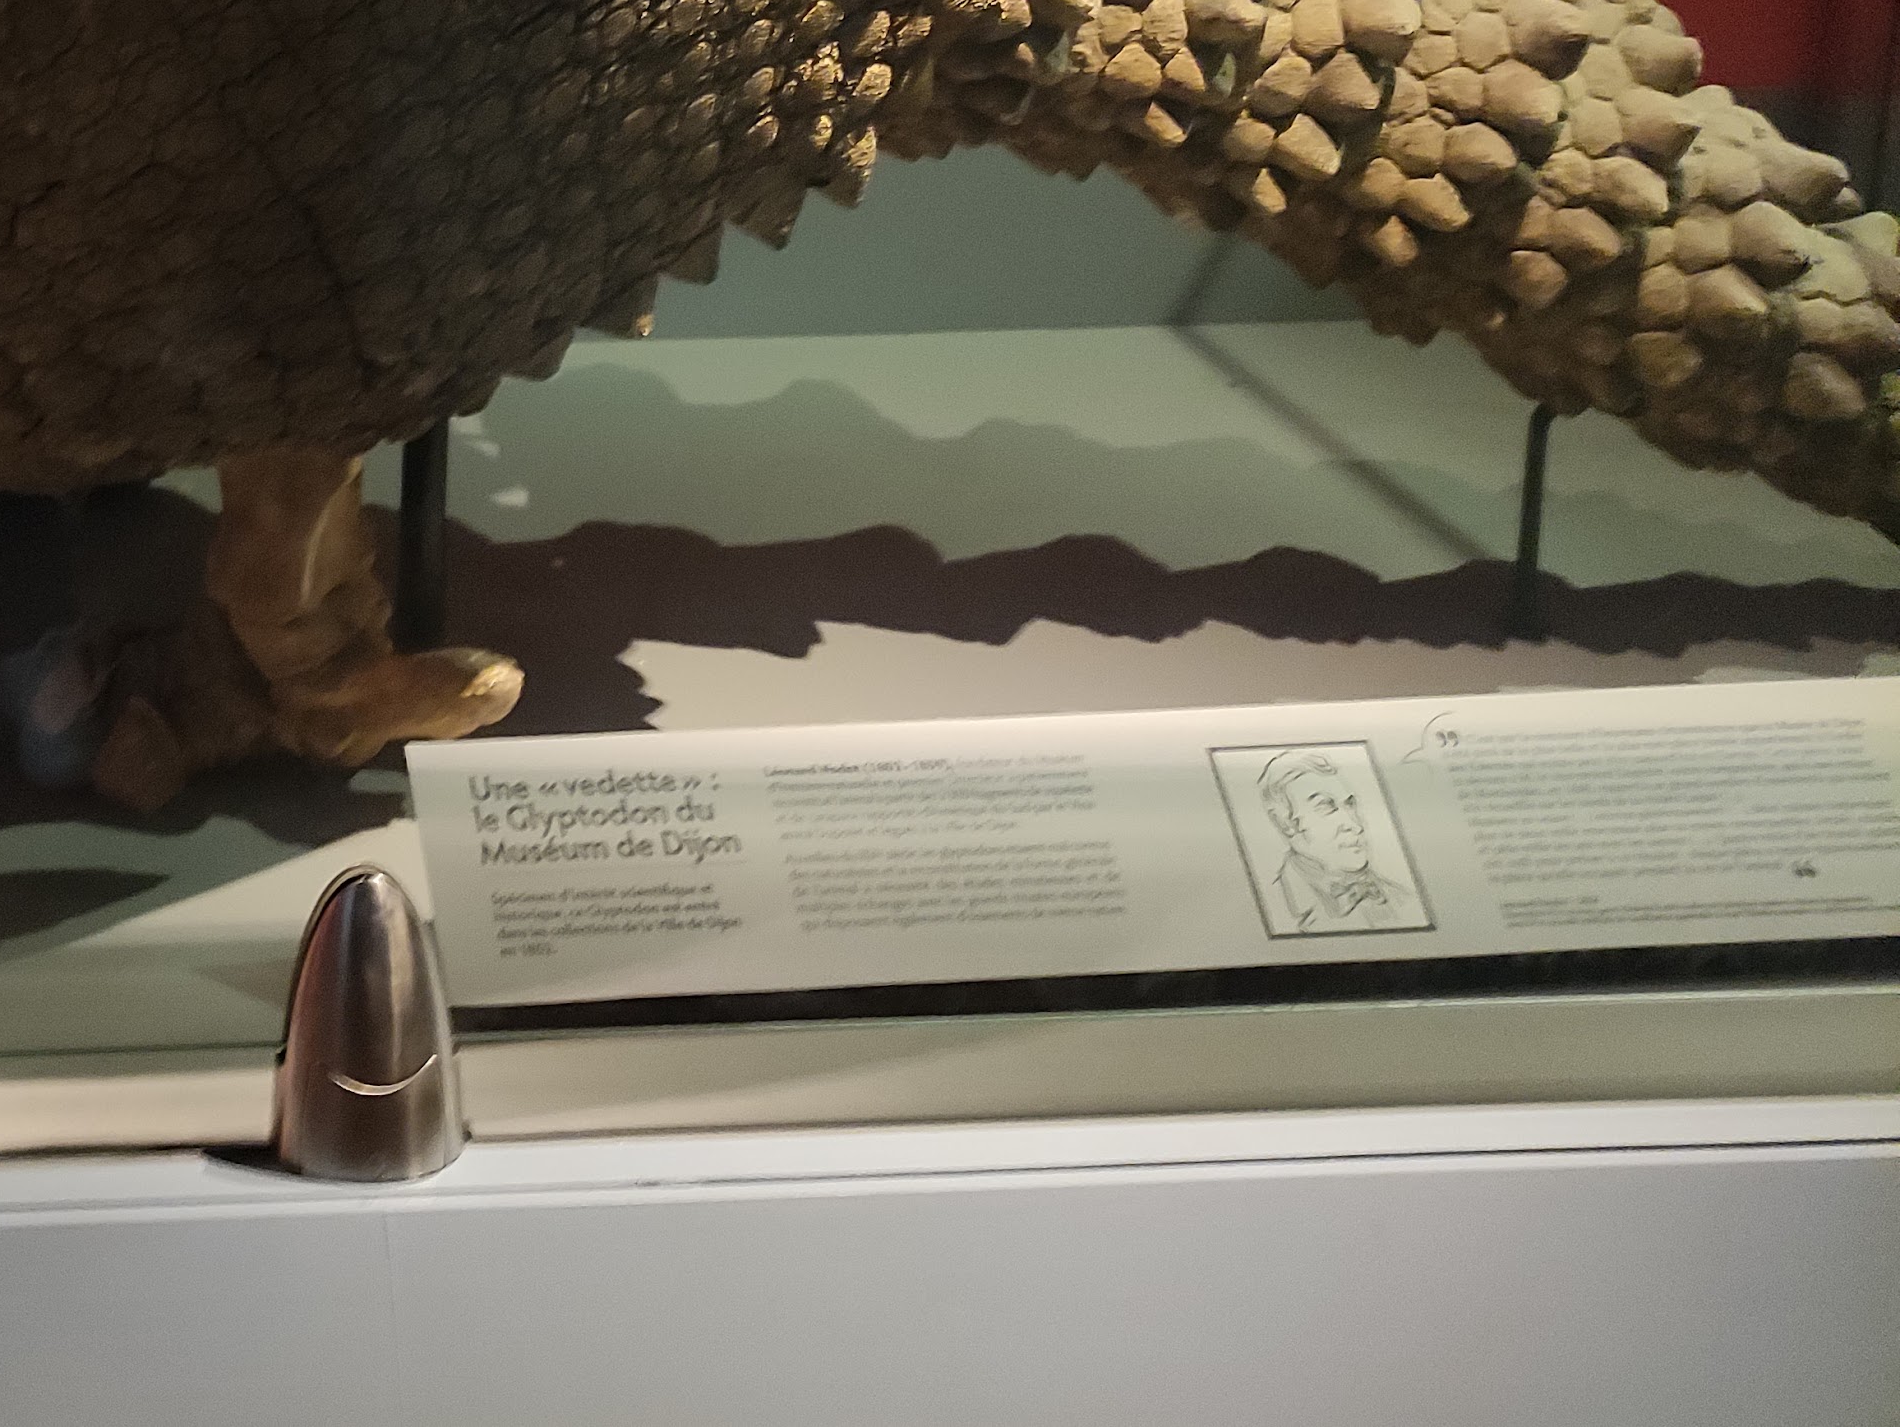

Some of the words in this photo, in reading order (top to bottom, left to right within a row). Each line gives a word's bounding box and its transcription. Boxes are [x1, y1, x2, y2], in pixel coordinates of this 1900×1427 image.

[469, 775, 529, 801] Une
[472, 805, 499, 833] le
[506, 797, 669, 838] Glyptodon
[675, 795, 714, 822] du
[481, 835, 610, 865] Muséum
[617, 830, 654, 858] de
[661, 830, 742, 865] Dijon
